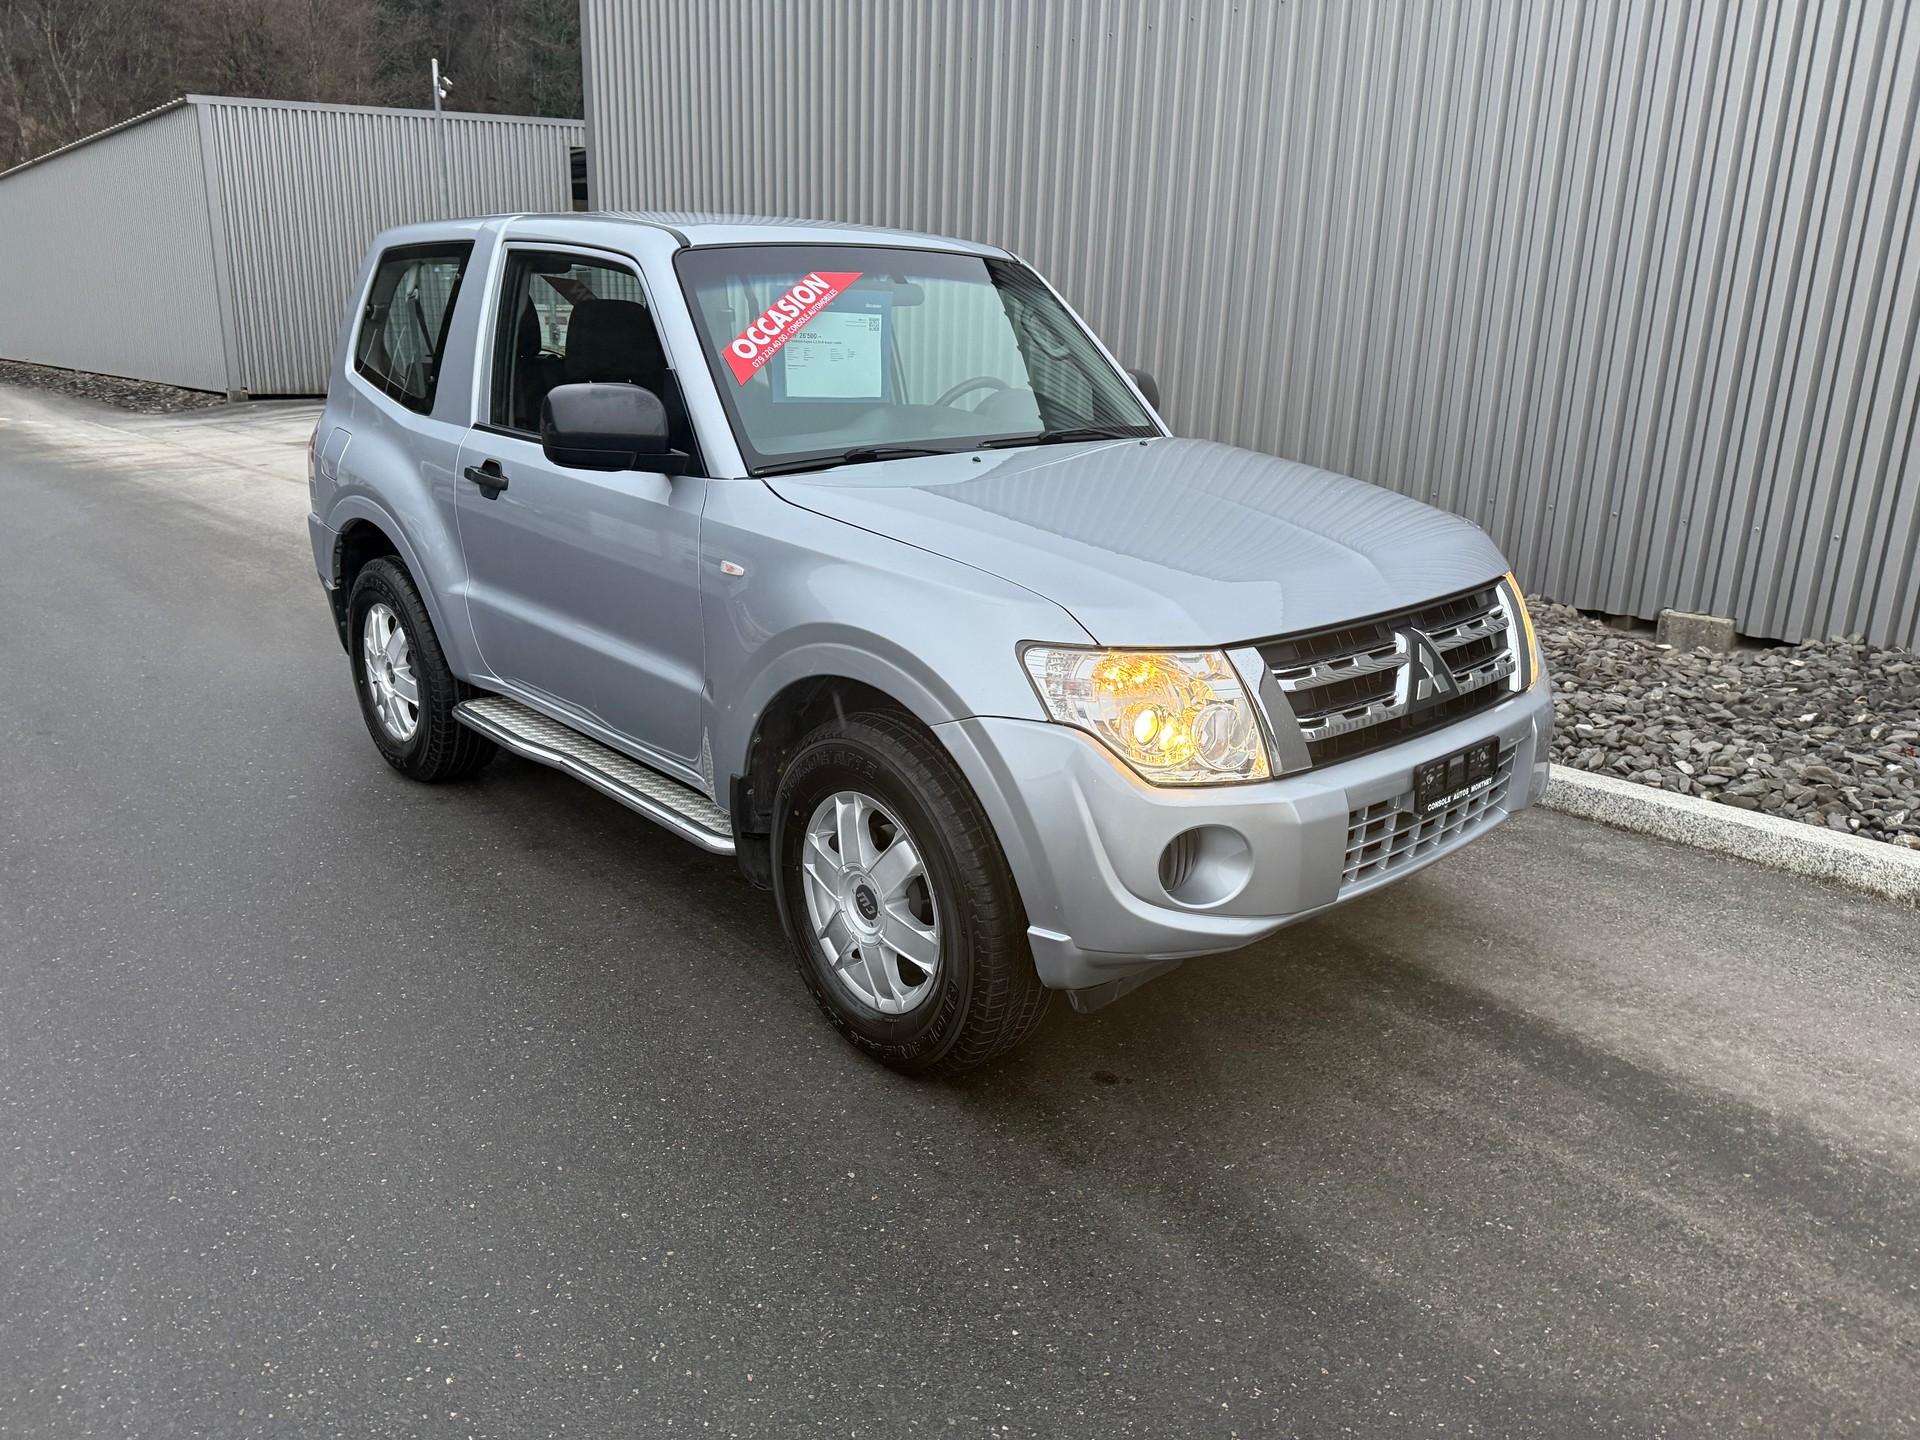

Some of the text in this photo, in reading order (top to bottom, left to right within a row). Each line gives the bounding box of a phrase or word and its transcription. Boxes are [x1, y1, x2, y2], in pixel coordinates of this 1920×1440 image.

[732, 273, 831, 359] OCCASION
[752, 356, 765, 368] 079
[762, 347, 775, 358] 220
[772, 340, 781, 349] 40
[778, 333, 788, 343] 00
[787, 313, 811, 334] CONSOLE
[807, 288, 839, 317] AUTOMOBILES
[1427, 795, 1451, 812] CONSOLE
[1453, 787, 1469, 801] AUTOS
